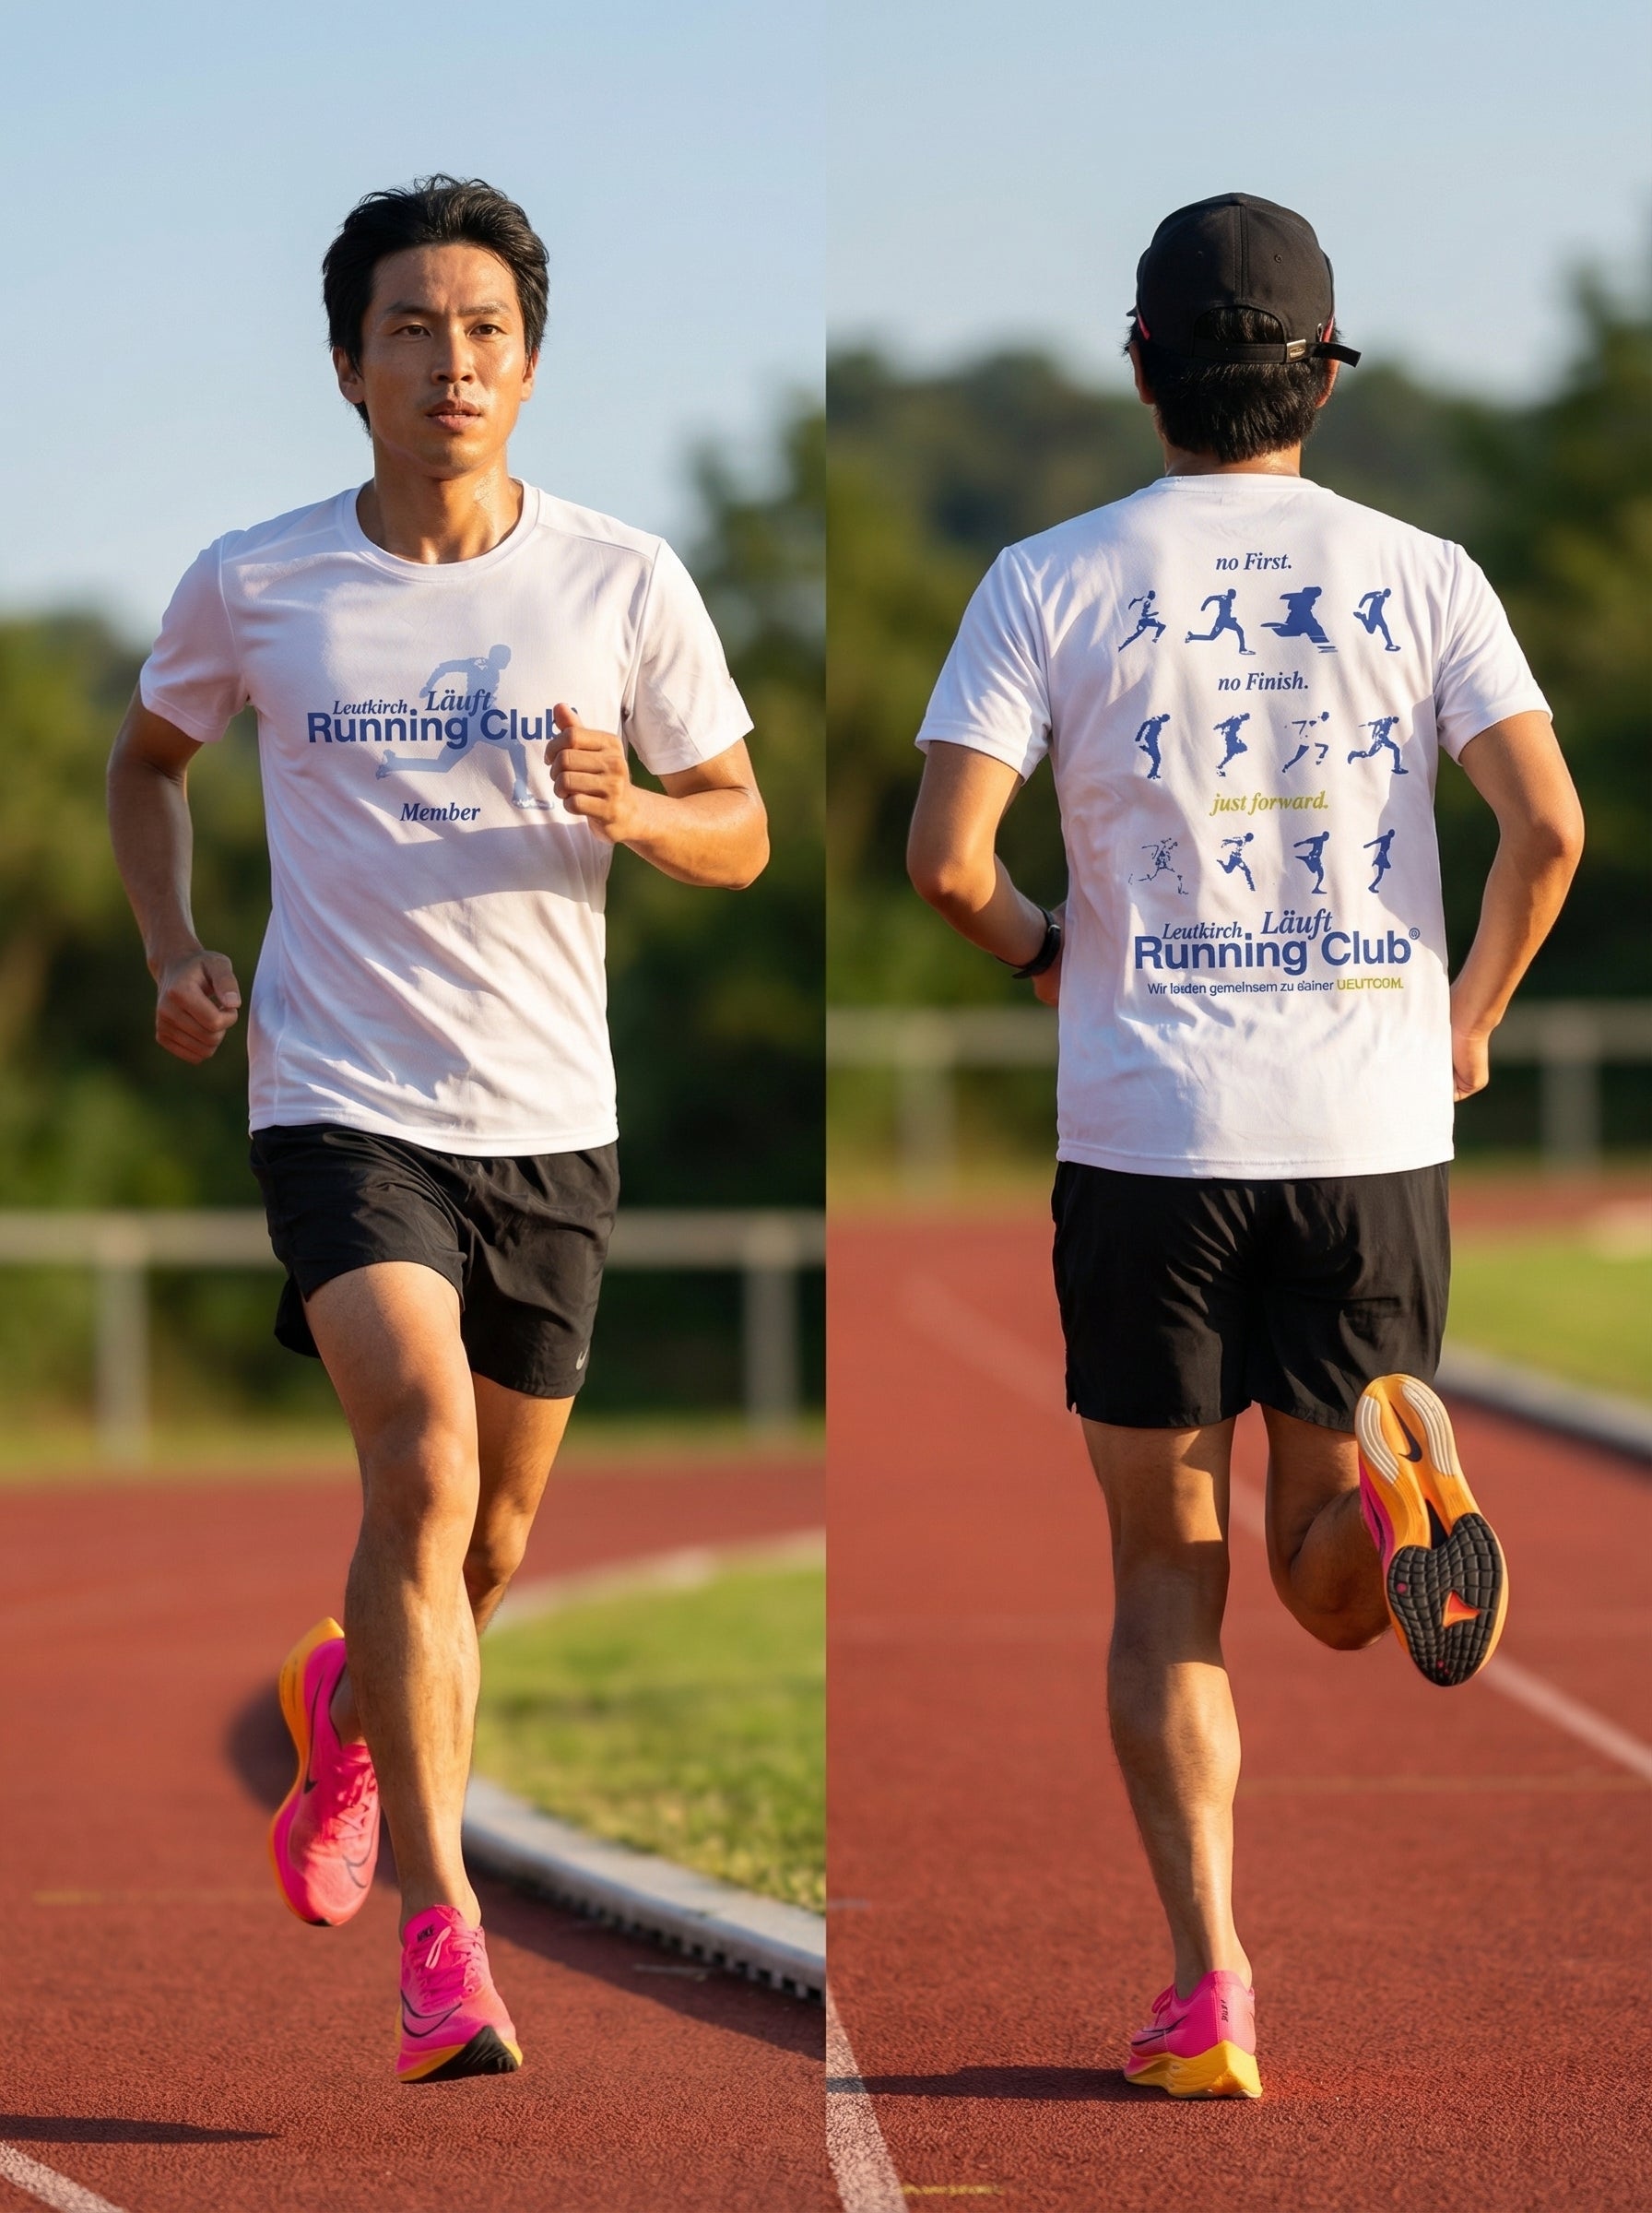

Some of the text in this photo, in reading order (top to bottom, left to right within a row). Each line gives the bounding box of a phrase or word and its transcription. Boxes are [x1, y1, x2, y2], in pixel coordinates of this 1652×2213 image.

[1215, 552, 1292, 571] no First.
[1218, 671, 1309, 692] no Finish.
[332, 689, 493, 716] Leutkirch Läuft
[307, 708, 468, 750] Running
[399, 802, 481, 822] Member
[1210, 790, 1329, 817] just forward.
[1162, 908, 1334, 941] Leutkirch Läuft
[1134, 932, 1308, 976] Running
[1148, 983, 1168, 995] Wir
[1280, 983, 1294, 991] zu
